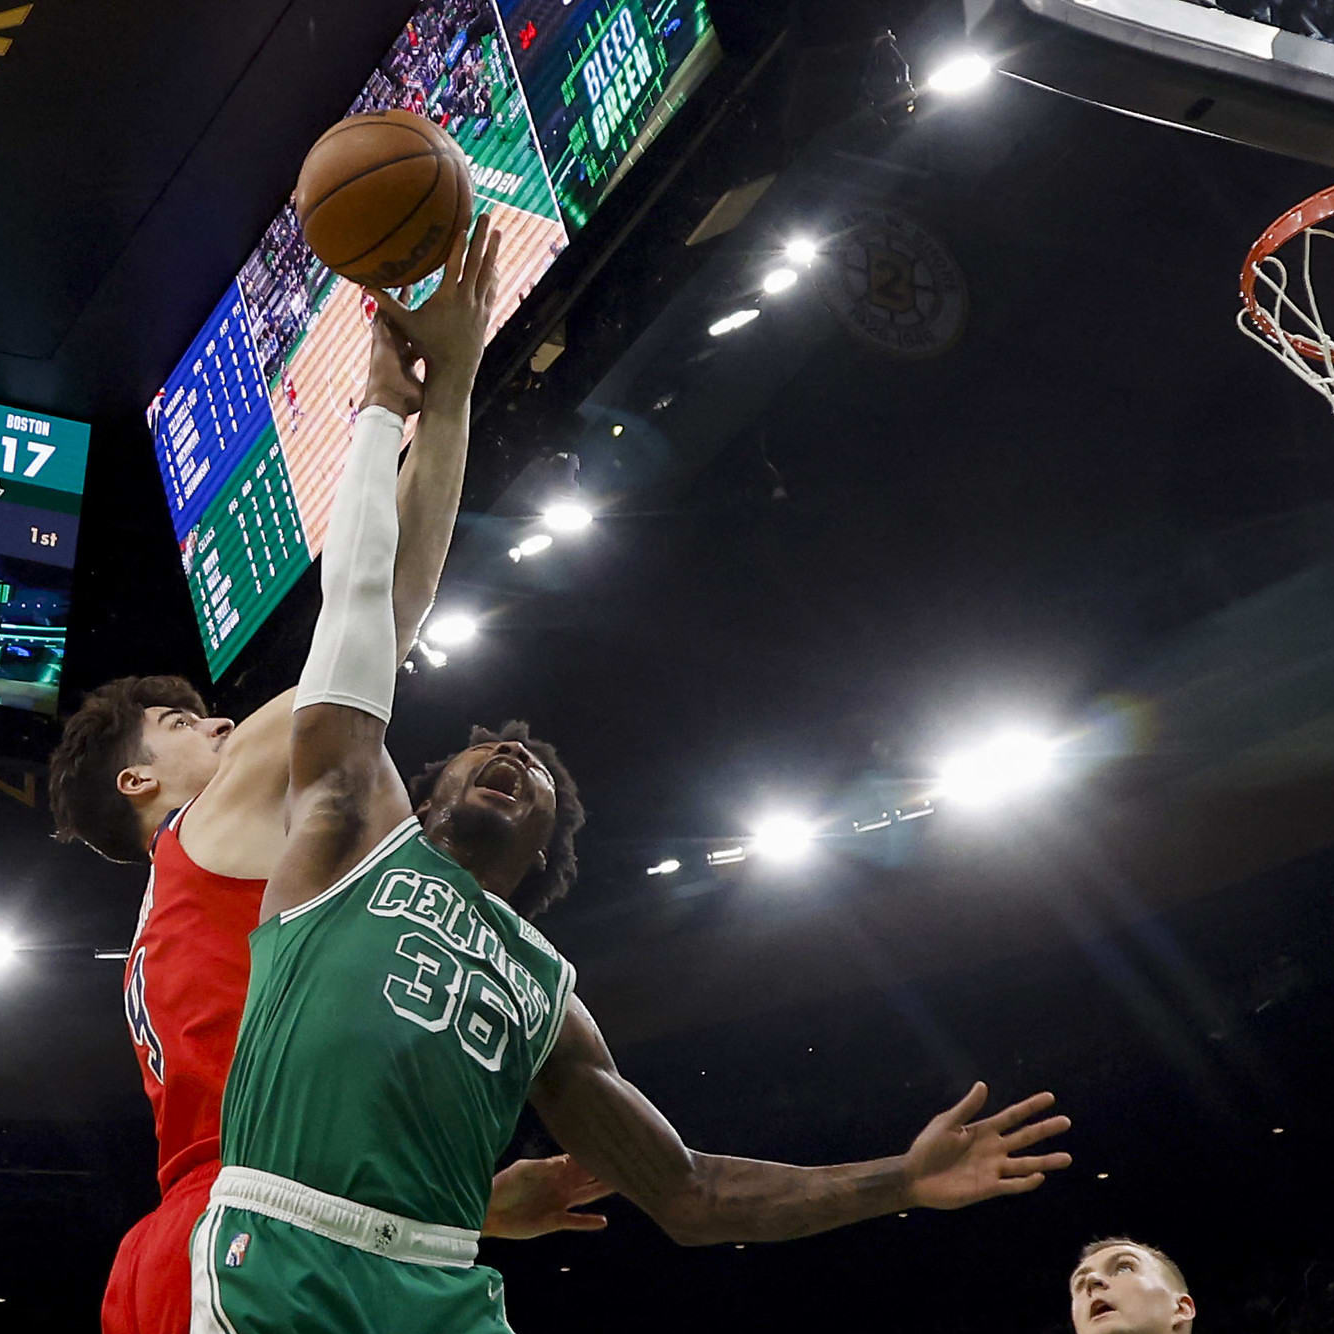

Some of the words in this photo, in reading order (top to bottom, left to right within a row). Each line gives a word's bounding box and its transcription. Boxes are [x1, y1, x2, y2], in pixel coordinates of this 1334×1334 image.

[582, 7, 637, 104] BLEED
[590, 35, 653, 150] GREEN
[468, 161, 524, 196] GARDEN
[1, 435, 56, 478] 17
[5, 413, 51, 437] BOSTON
[30, 527, 58, 547] 1st
[367, 868, 551, 1040] CELTICS
[383, 932, 520, 1072] 36
